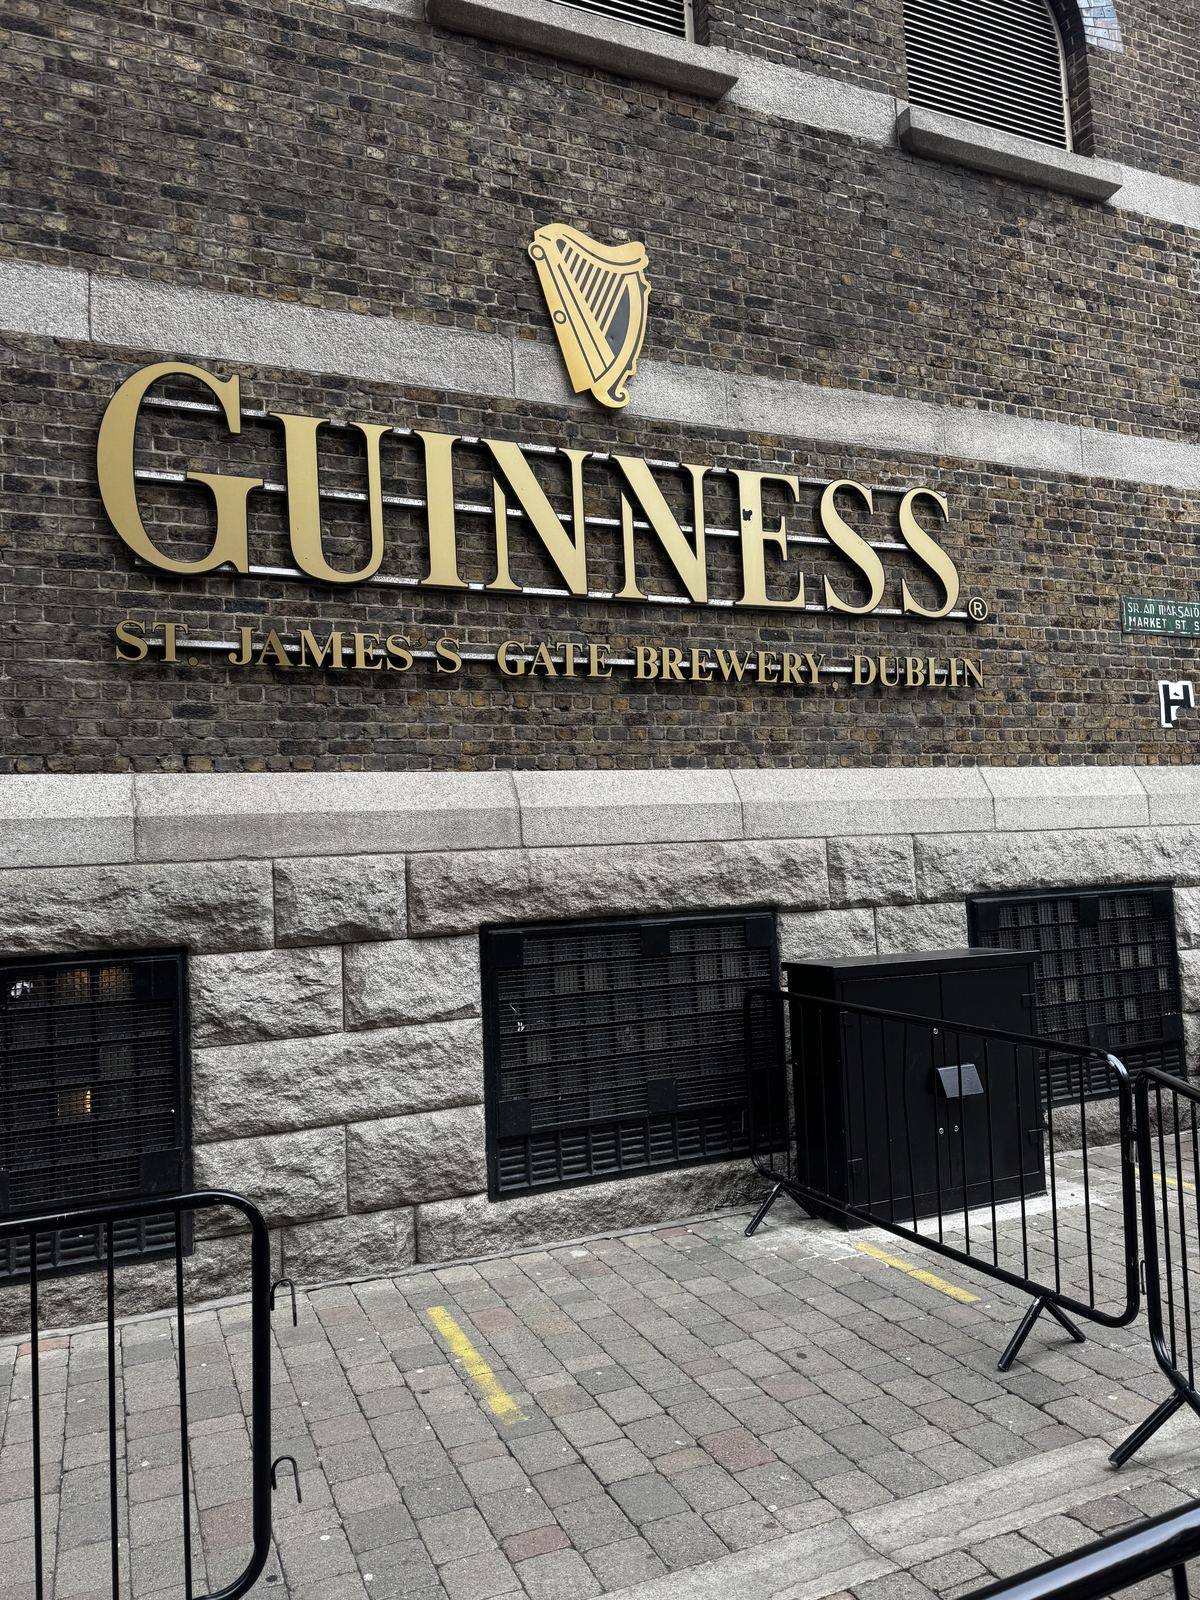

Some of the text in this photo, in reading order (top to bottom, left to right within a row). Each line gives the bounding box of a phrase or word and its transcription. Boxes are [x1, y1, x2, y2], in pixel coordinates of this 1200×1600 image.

[97, 361, 960, 618] GUINNESS
[1127, 601, 1142, 614] SR.
[1128, 615, 1167, 629] MARKET
[115, 619, 985, 692] ST. JAMES'S GATE BREWERY, DUBLIN
